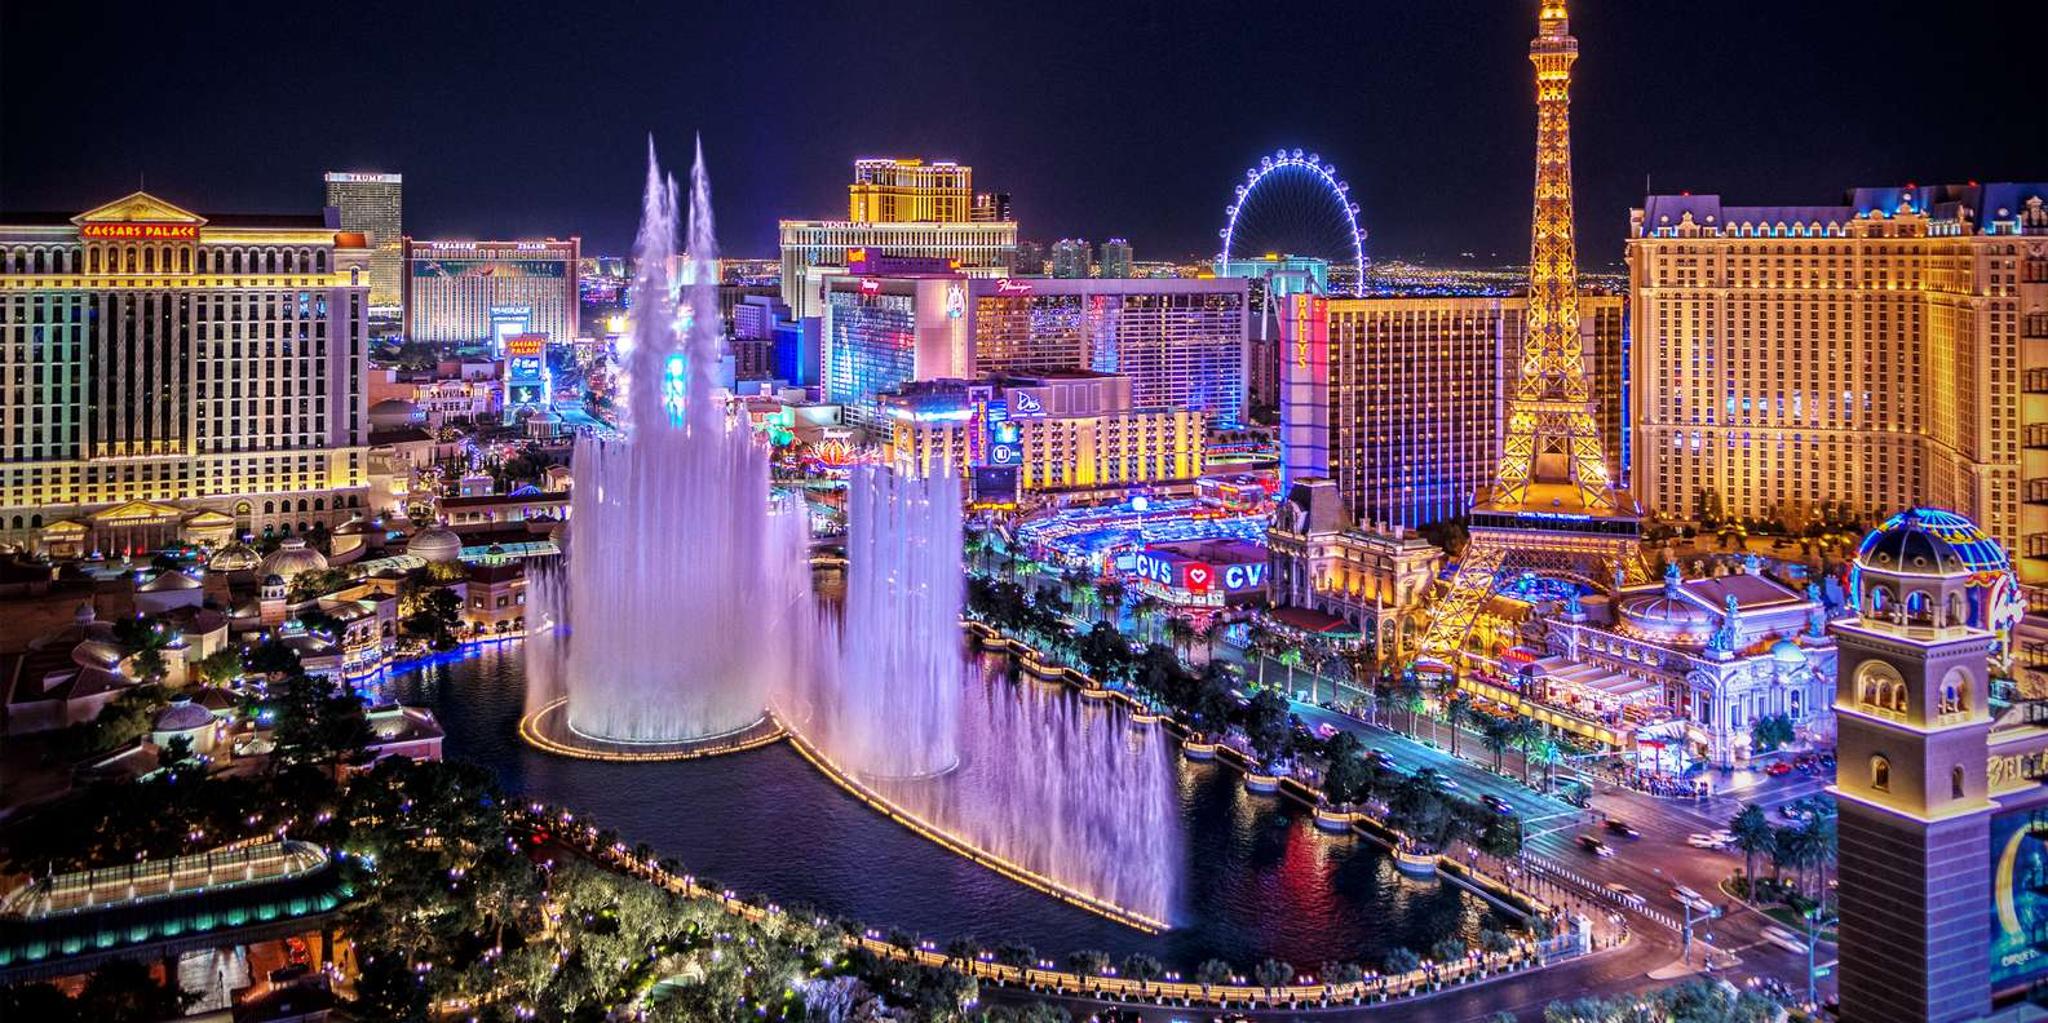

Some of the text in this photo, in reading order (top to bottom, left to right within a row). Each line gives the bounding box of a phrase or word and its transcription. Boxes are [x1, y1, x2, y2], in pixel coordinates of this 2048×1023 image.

[351, 173, 383, 183] TRUMP
[821, 220, 871, 229] VENETIAN
[84, 226, 195, 237] CAESARS PALACE
[1136, 554, 1172, 584] CVS
